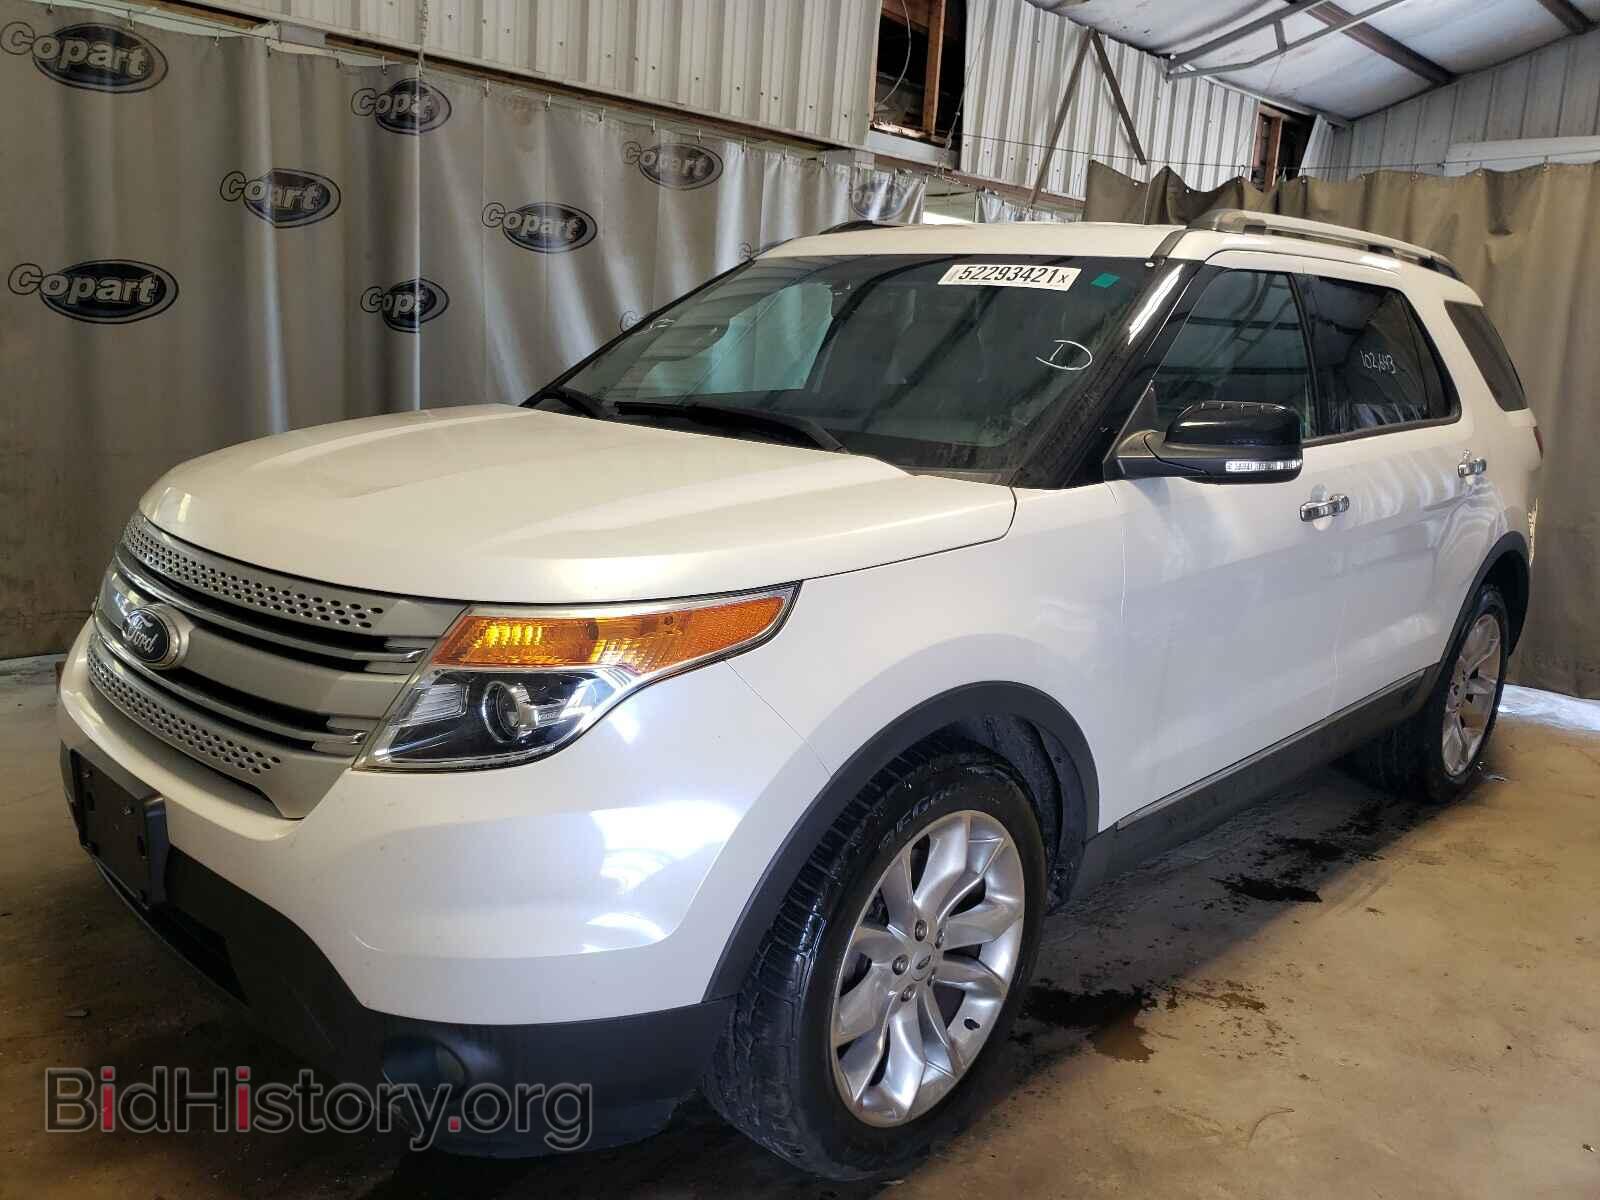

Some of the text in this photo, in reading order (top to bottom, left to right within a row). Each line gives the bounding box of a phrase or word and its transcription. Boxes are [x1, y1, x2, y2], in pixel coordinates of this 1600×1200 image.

[0, 21, 148, 78] Copart
[482, 202, 578, 241] Copart
[8, 263, 159, 305] Copart
[958, 266, 1057, 284] 52293421
[127, 614, 160, 654] Ford
